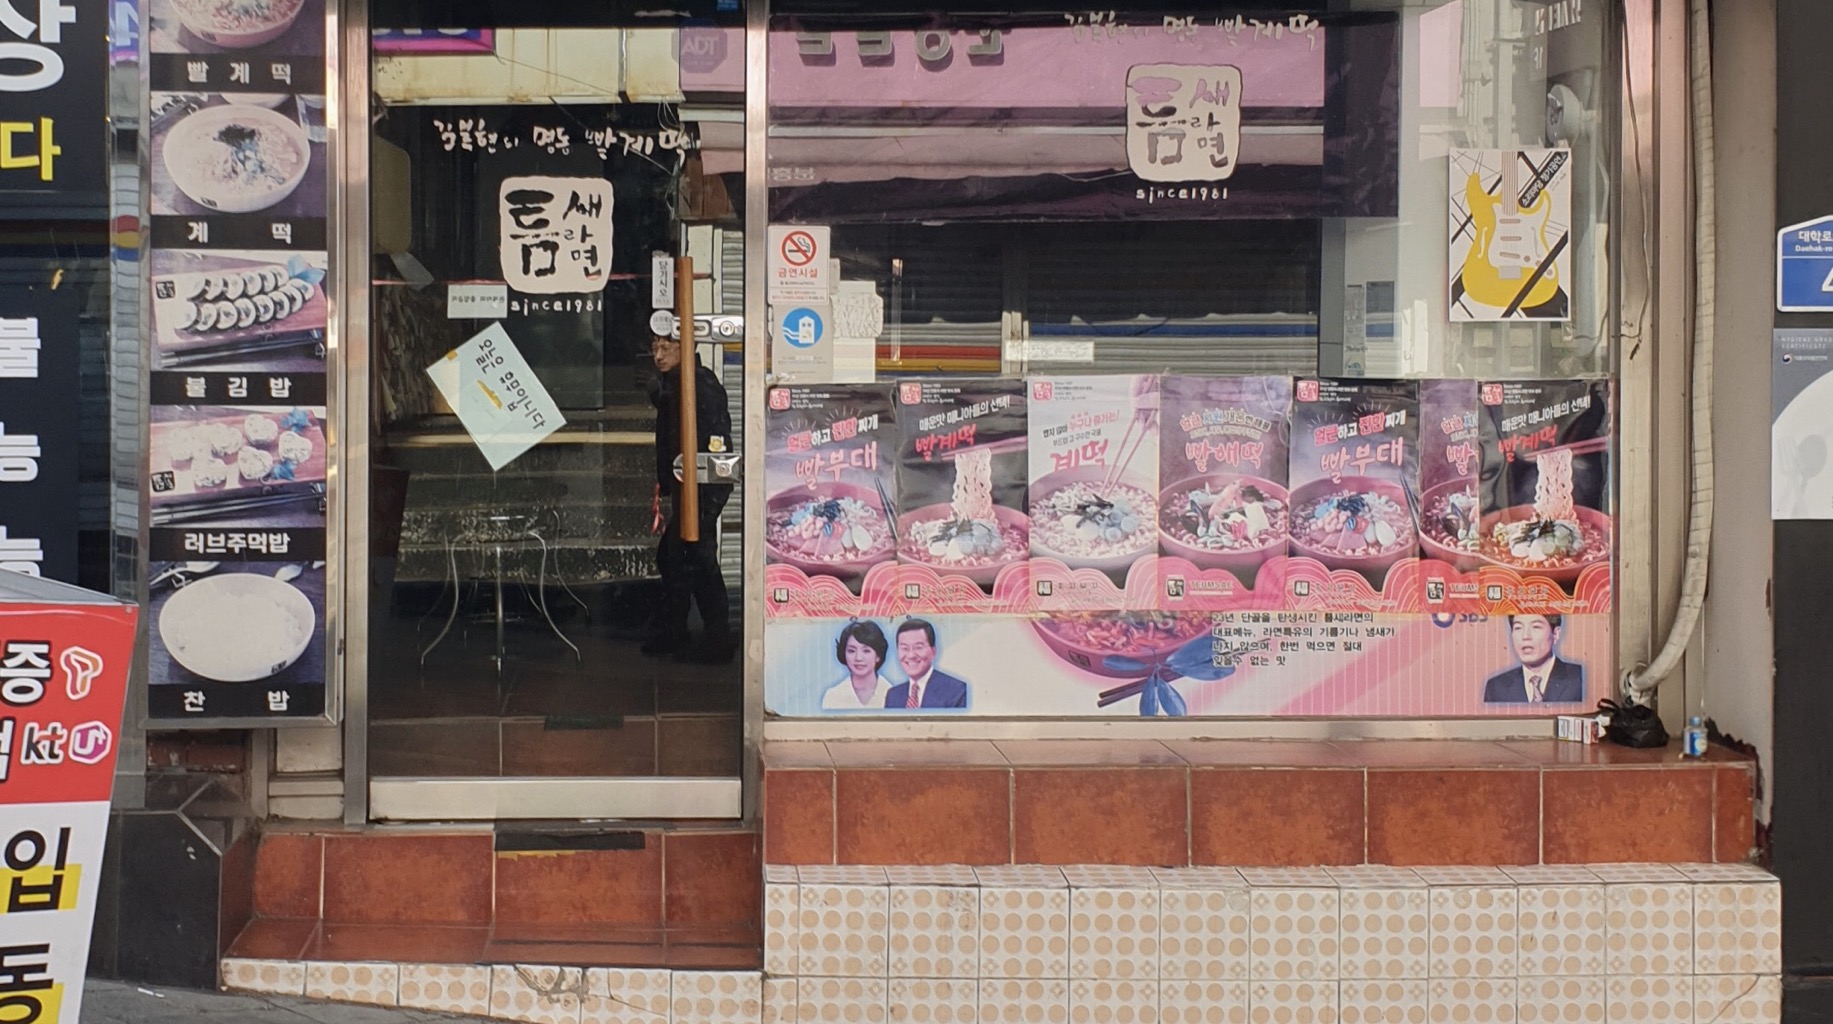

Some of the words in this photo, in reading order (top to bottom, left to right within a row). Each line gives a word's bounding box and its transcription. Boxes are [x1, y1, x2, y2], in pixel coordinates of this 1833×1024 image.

[533, 126, 570, 156] 명동
[778, 267, 819, 279] 금연시설
[475, 338, 505, 375] 오늘은
[795, 440, 877, 491] 빨부대
[1320, 436, 1404, 484] 빨부대
[184, 532, 291, 555] 러브주먹밥
[1263, 627, 1313, 637] 라면특유의
[1365, 627, 1395, 637] 냄새가
[1280, 641, 1299, 652] 한번
[1306, 641, 1336, 652] 먹으면
[1276, 655, 1286, 666] 맛
[4, 827, 71, 913] 입
